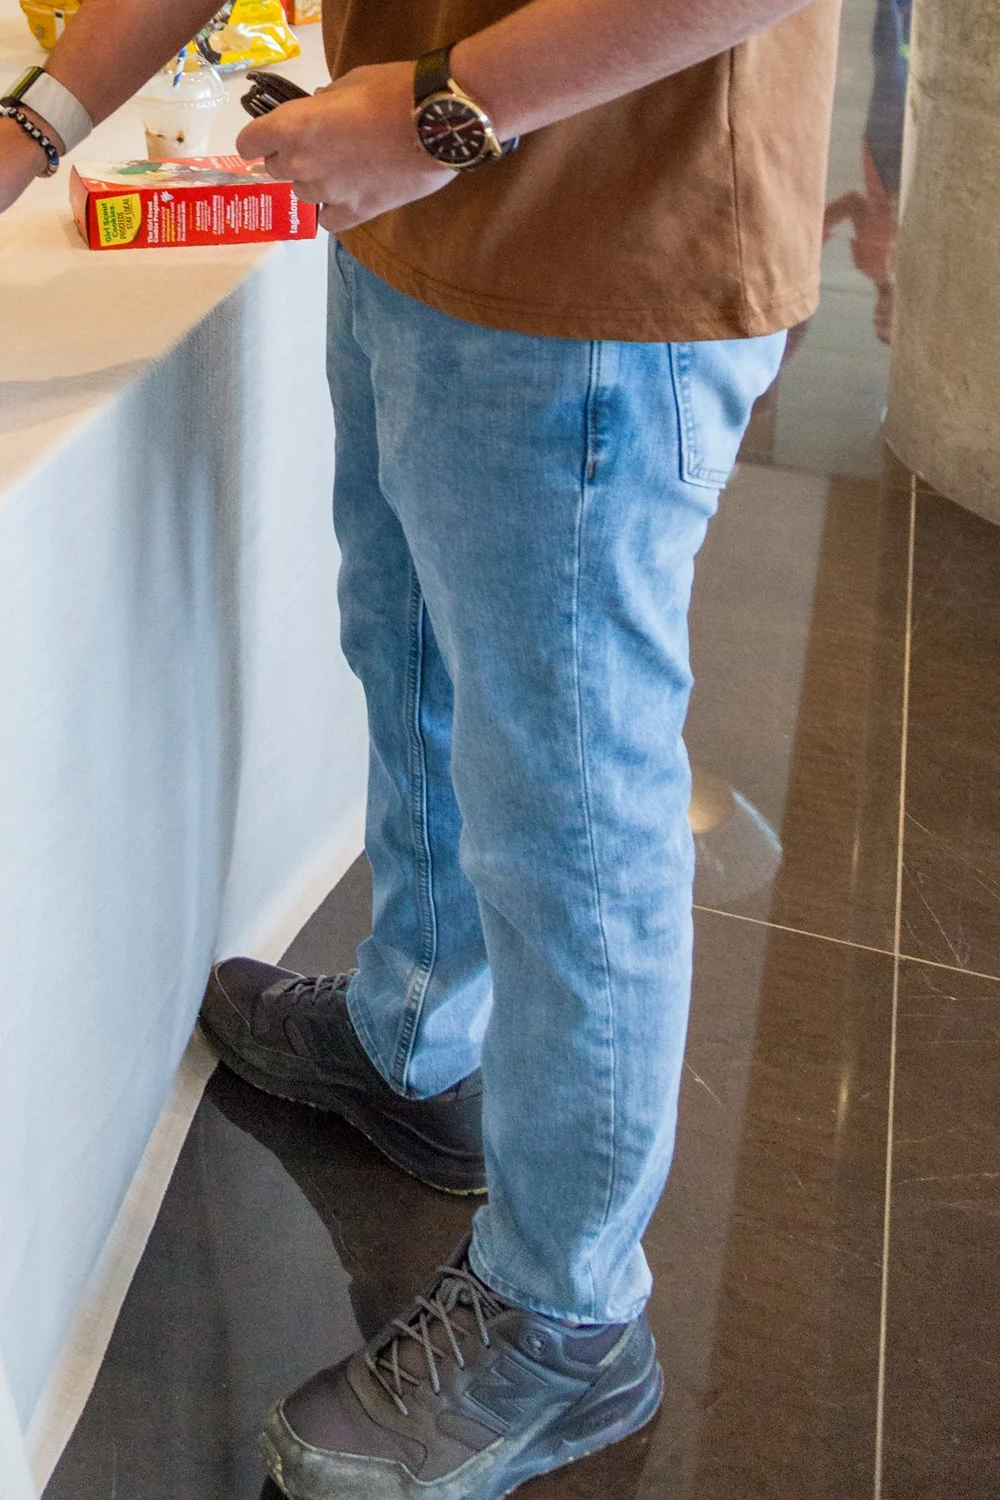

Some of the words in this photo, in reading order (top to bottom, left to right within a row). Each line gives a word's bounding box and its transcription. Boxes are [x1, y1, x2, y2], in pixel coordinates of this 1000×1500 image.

[101, 202, 110, 226] Scout
[122, 198, 132, 215] LOCAL
[109, 205, 118, 238] Cookies
[117, 211, 127, 240] PROCEEDS
[126, 216, 134, 229] STAY
